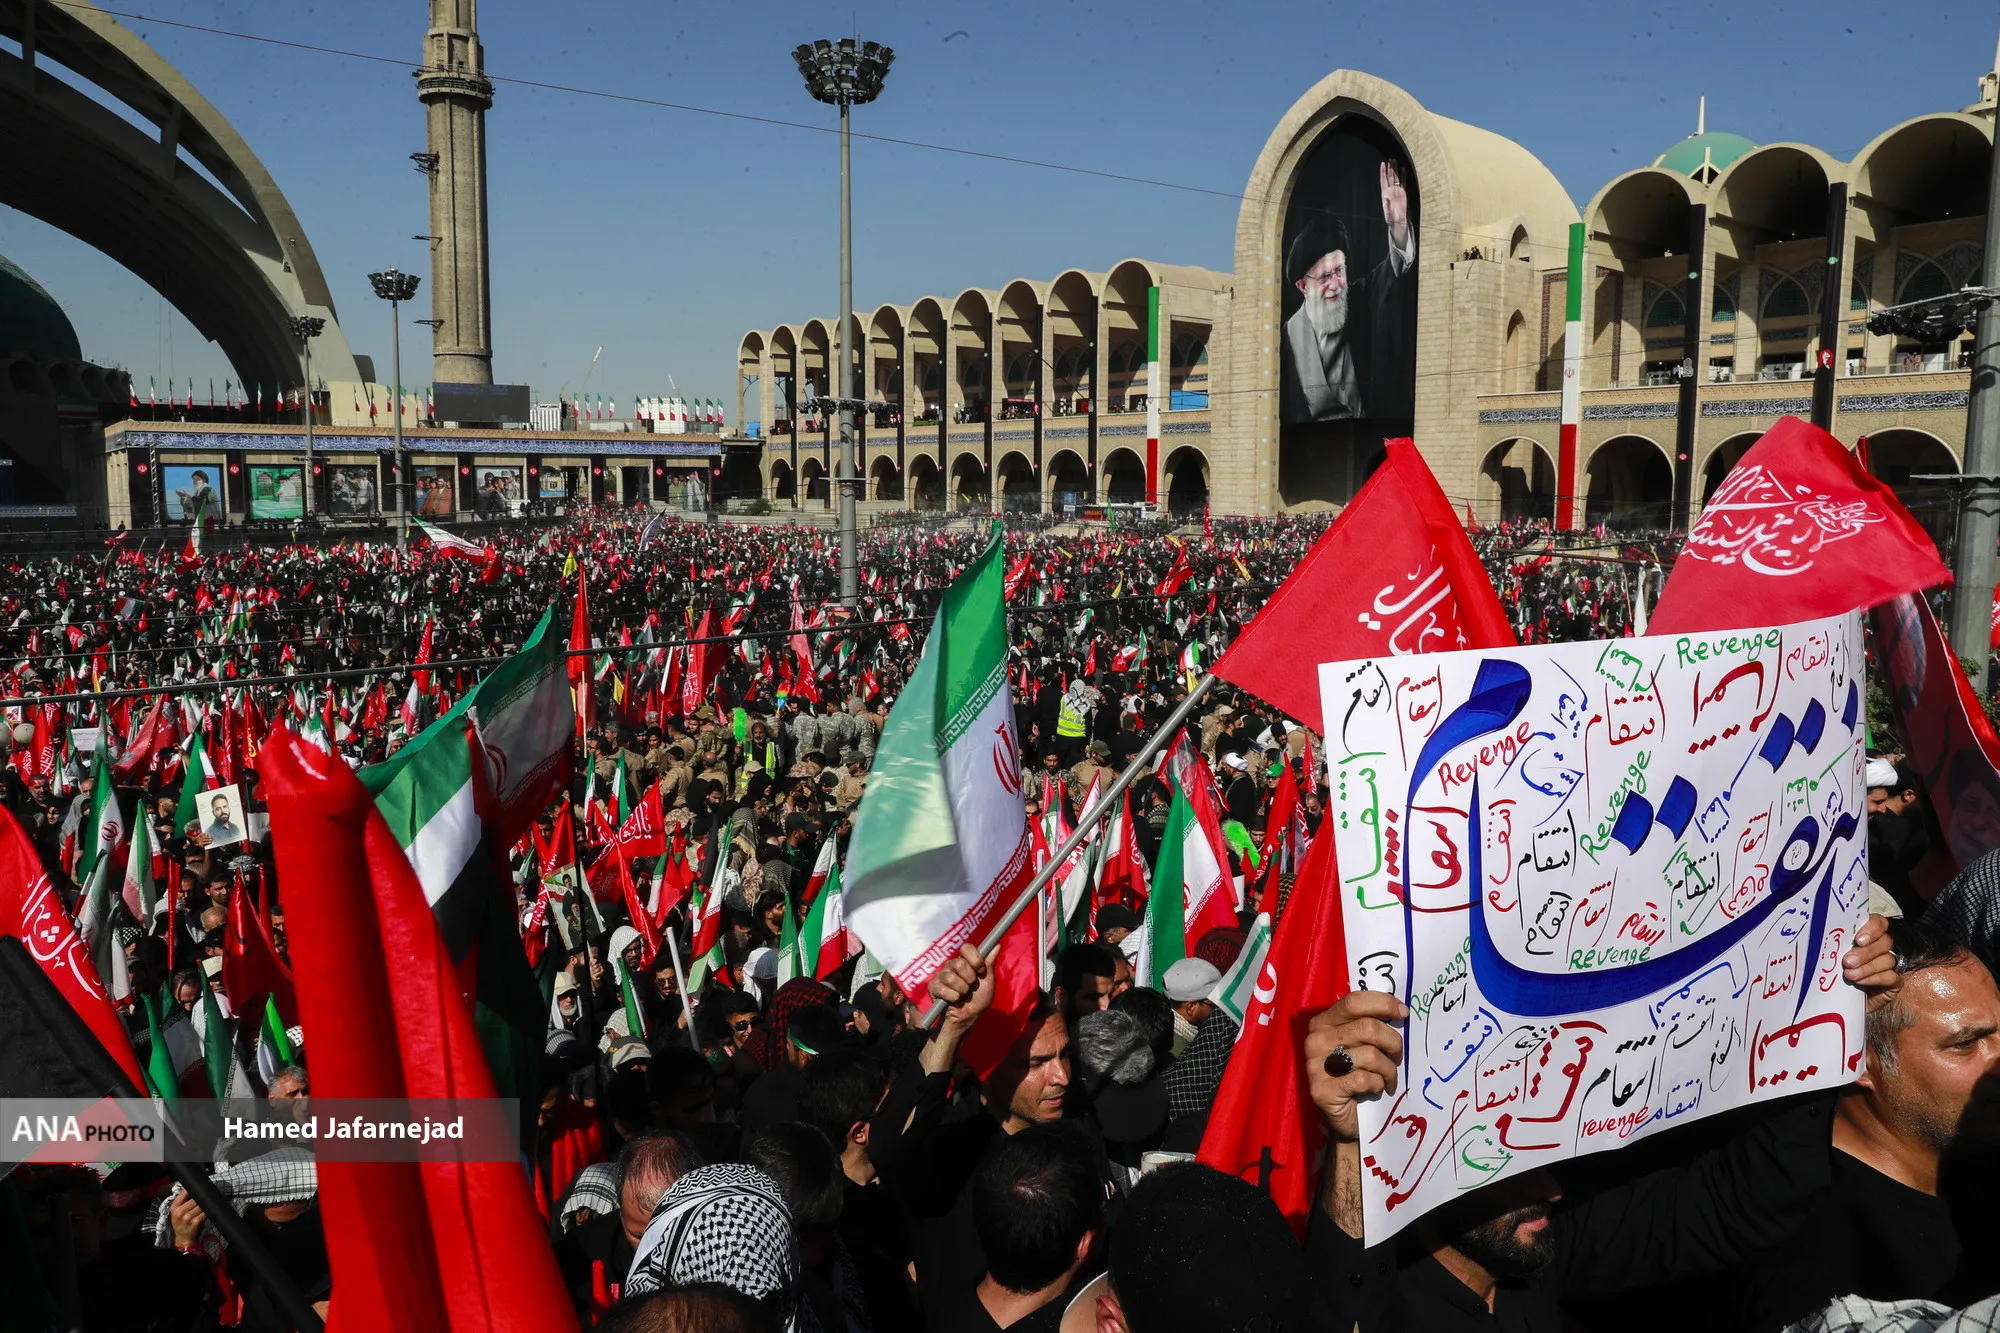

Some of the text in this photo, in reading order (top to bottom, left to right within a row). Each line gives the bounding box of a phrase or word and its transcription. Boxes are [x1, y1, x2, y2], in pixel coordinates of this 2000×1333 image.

[1676, 629, 1781, 669] Revenge
[1786, 631, 1830, 681] انتقام
[1343, 660, 1392, 758] انتقام
[1395, 663, 1442, 771] انتقام
[1585, 671, 1665, 823] انتقام
[1437, 721, 1536, 796] Revenge
[1580, 750, 1651, 866] Revenge
[1517, 808, 1577, 930] انتقام
[1565, 866, 1619, 964] انتقام
[1616, 901, 1666, 946] انتقام
[1410, 935, 1476, 1021] Revenge
[1744, 940, 1798, 1052] انتقام
[1423, 1006, 1503, 1110] انتقام
[1575, 1035, 1657, 1157] انتقام
[1451, 1053, 1528, 1180] انتقام
[1581, 1105, 1650, 1138] revenge
[1630, 1078, 1702, 1137] انتقام
